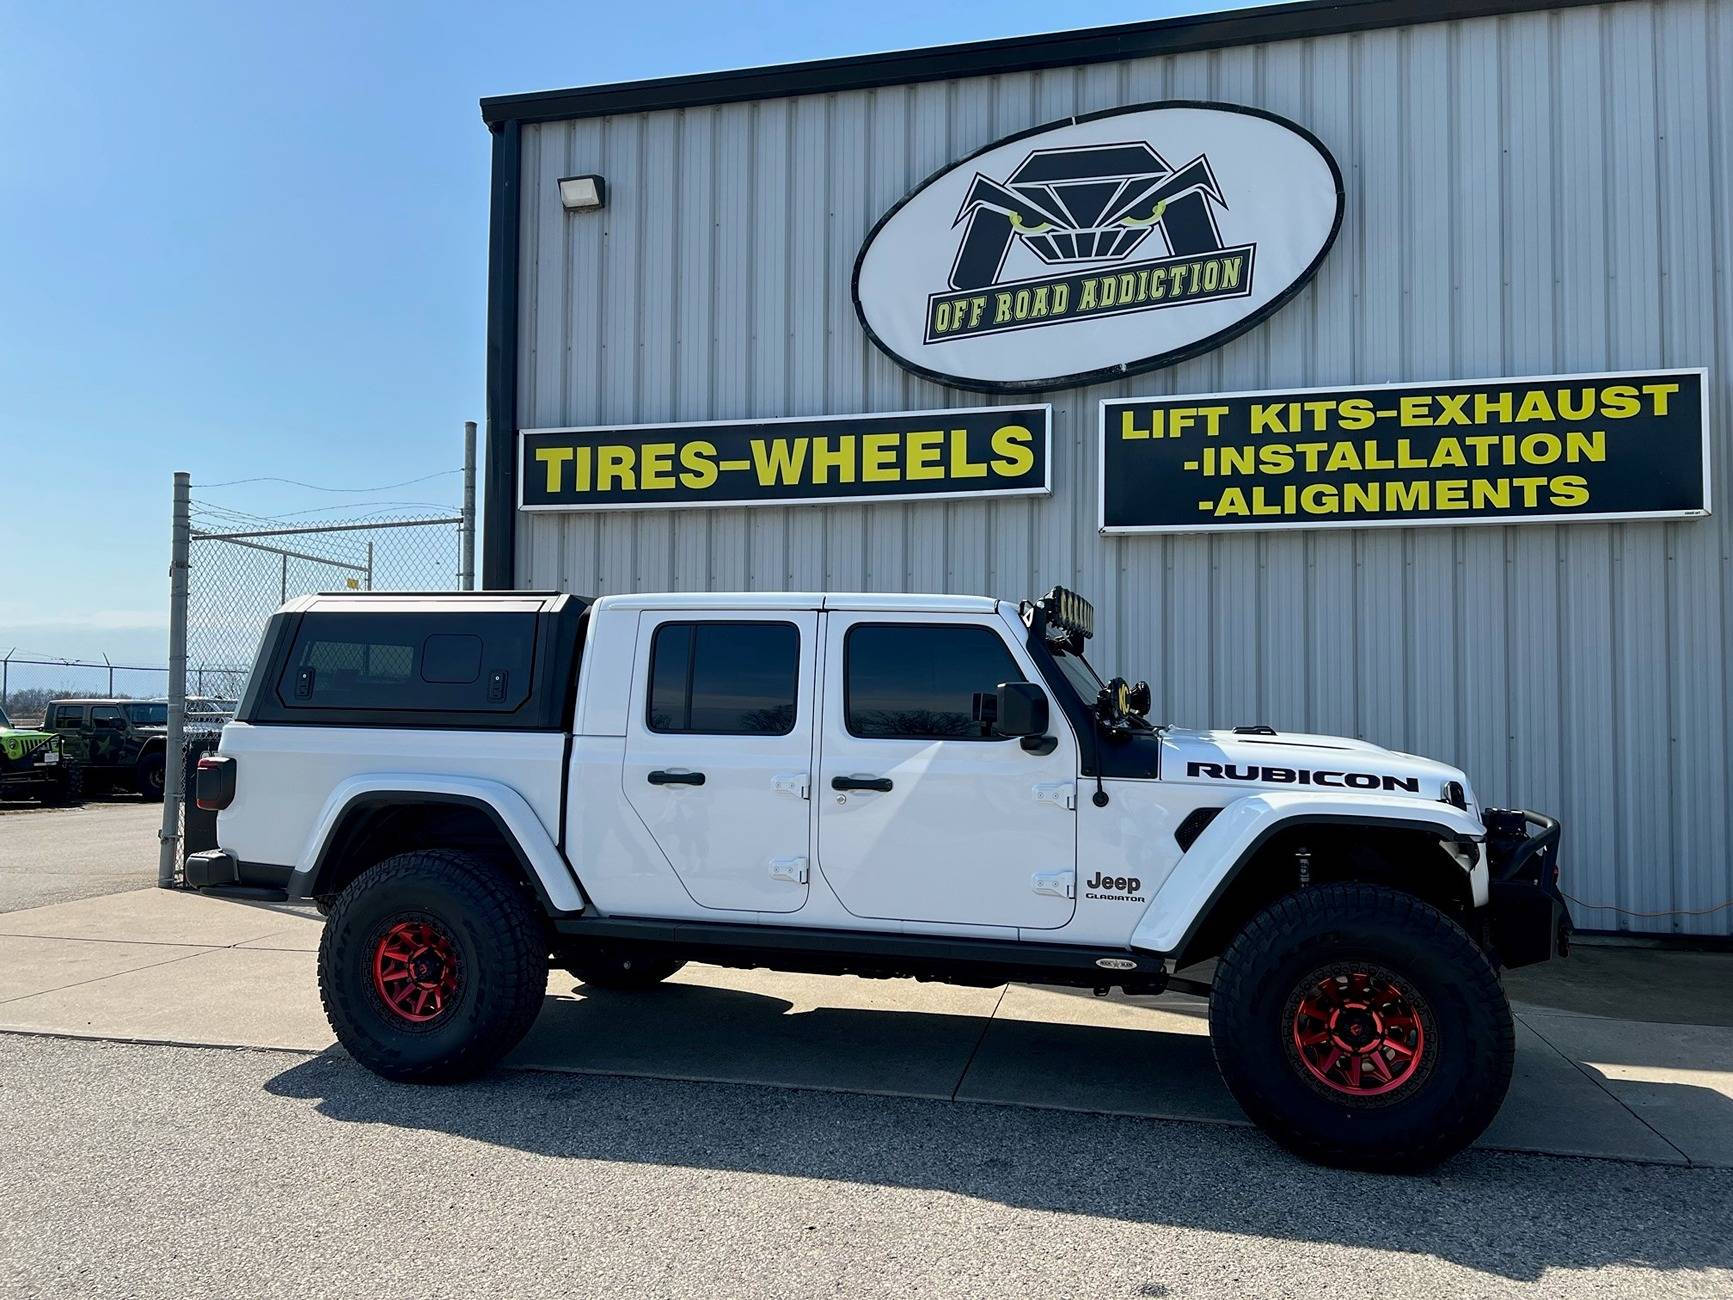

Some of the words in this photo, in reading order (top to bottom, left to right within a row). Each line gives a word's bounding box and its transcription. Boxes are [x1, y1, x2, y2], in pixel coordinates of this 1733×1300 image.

[935, 296, 987, 333] OFF
[993, 283, 1071, 324] ROAD
[1076, 256, 1243, 311] ADDICTION
[1122, 406, 1229, 440] LIFT
[1250, 383, 1679, 434] KITS-EXHAUST
[535, 425, 1034, 493] TIRES-WHEELS
[1184, 431, 1606, 476] -INSTALLATION
[1199, 475, 1590, 517] -ALIGNMENTS
[1186, 761, 1420, 793] RUBICON
[1085, 892, 1145, 903] GLADIATOR
[1086, 871, 1141, 894] Jeep
